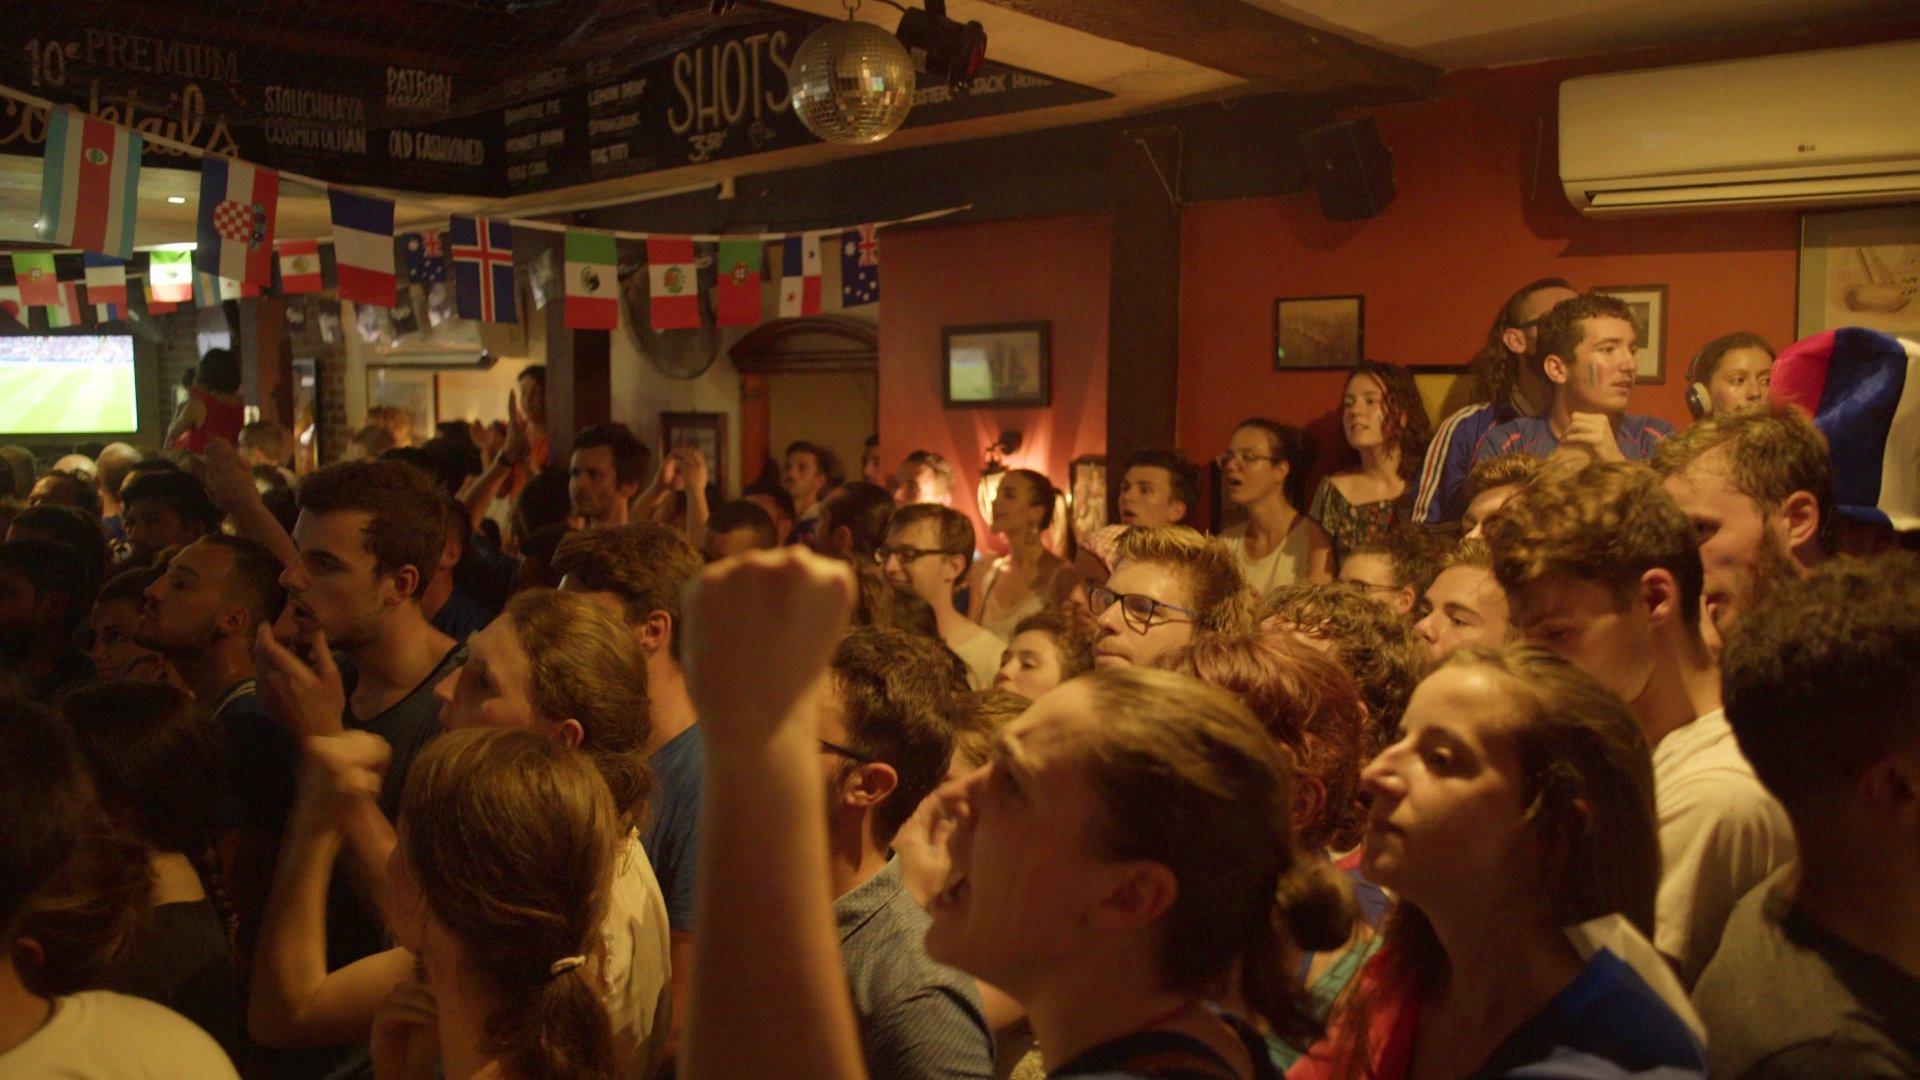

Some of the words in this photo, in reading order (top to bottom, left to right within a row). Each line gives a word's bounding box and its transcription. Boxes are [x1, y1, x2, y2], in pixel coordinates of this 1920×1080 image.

[86, 27, 239, 84] PREMIUM
[666, 30, 792, 134] SHOTS
[0, 79, 239, 158] oktails
